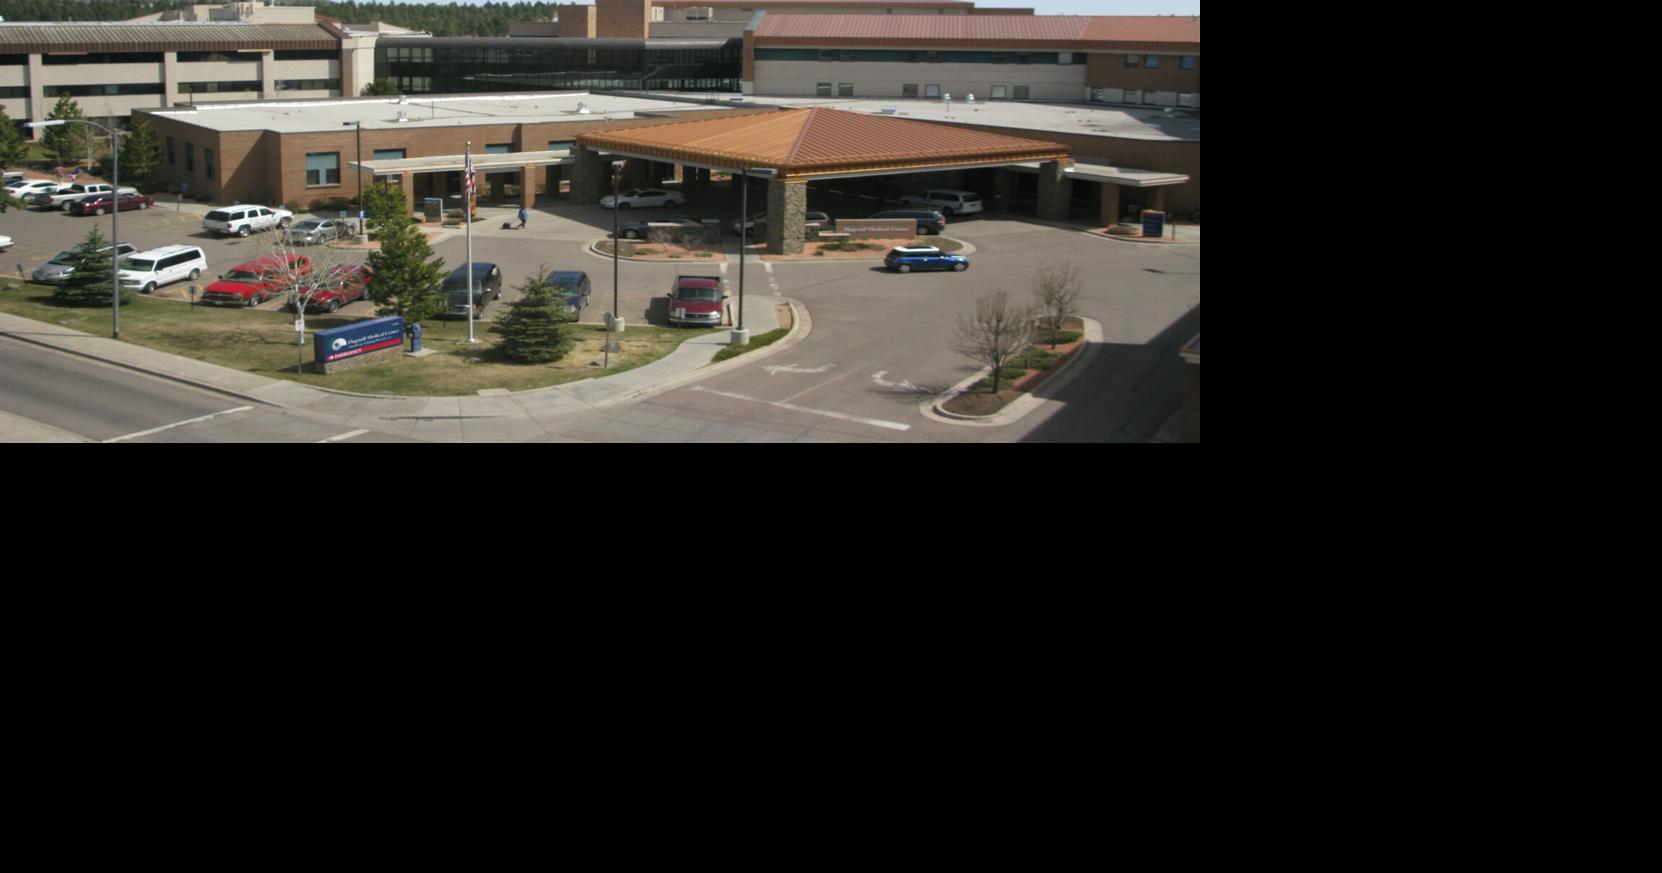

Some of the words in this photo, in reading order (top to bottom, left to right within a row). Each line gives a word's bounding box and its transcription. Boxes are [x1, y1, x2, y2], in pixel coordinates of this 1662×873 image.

[348, 335, 367, 345] Flagstaff
[367, 331, 385, 340] Medical
[334, 348, 363, 359] EMERGENCY
